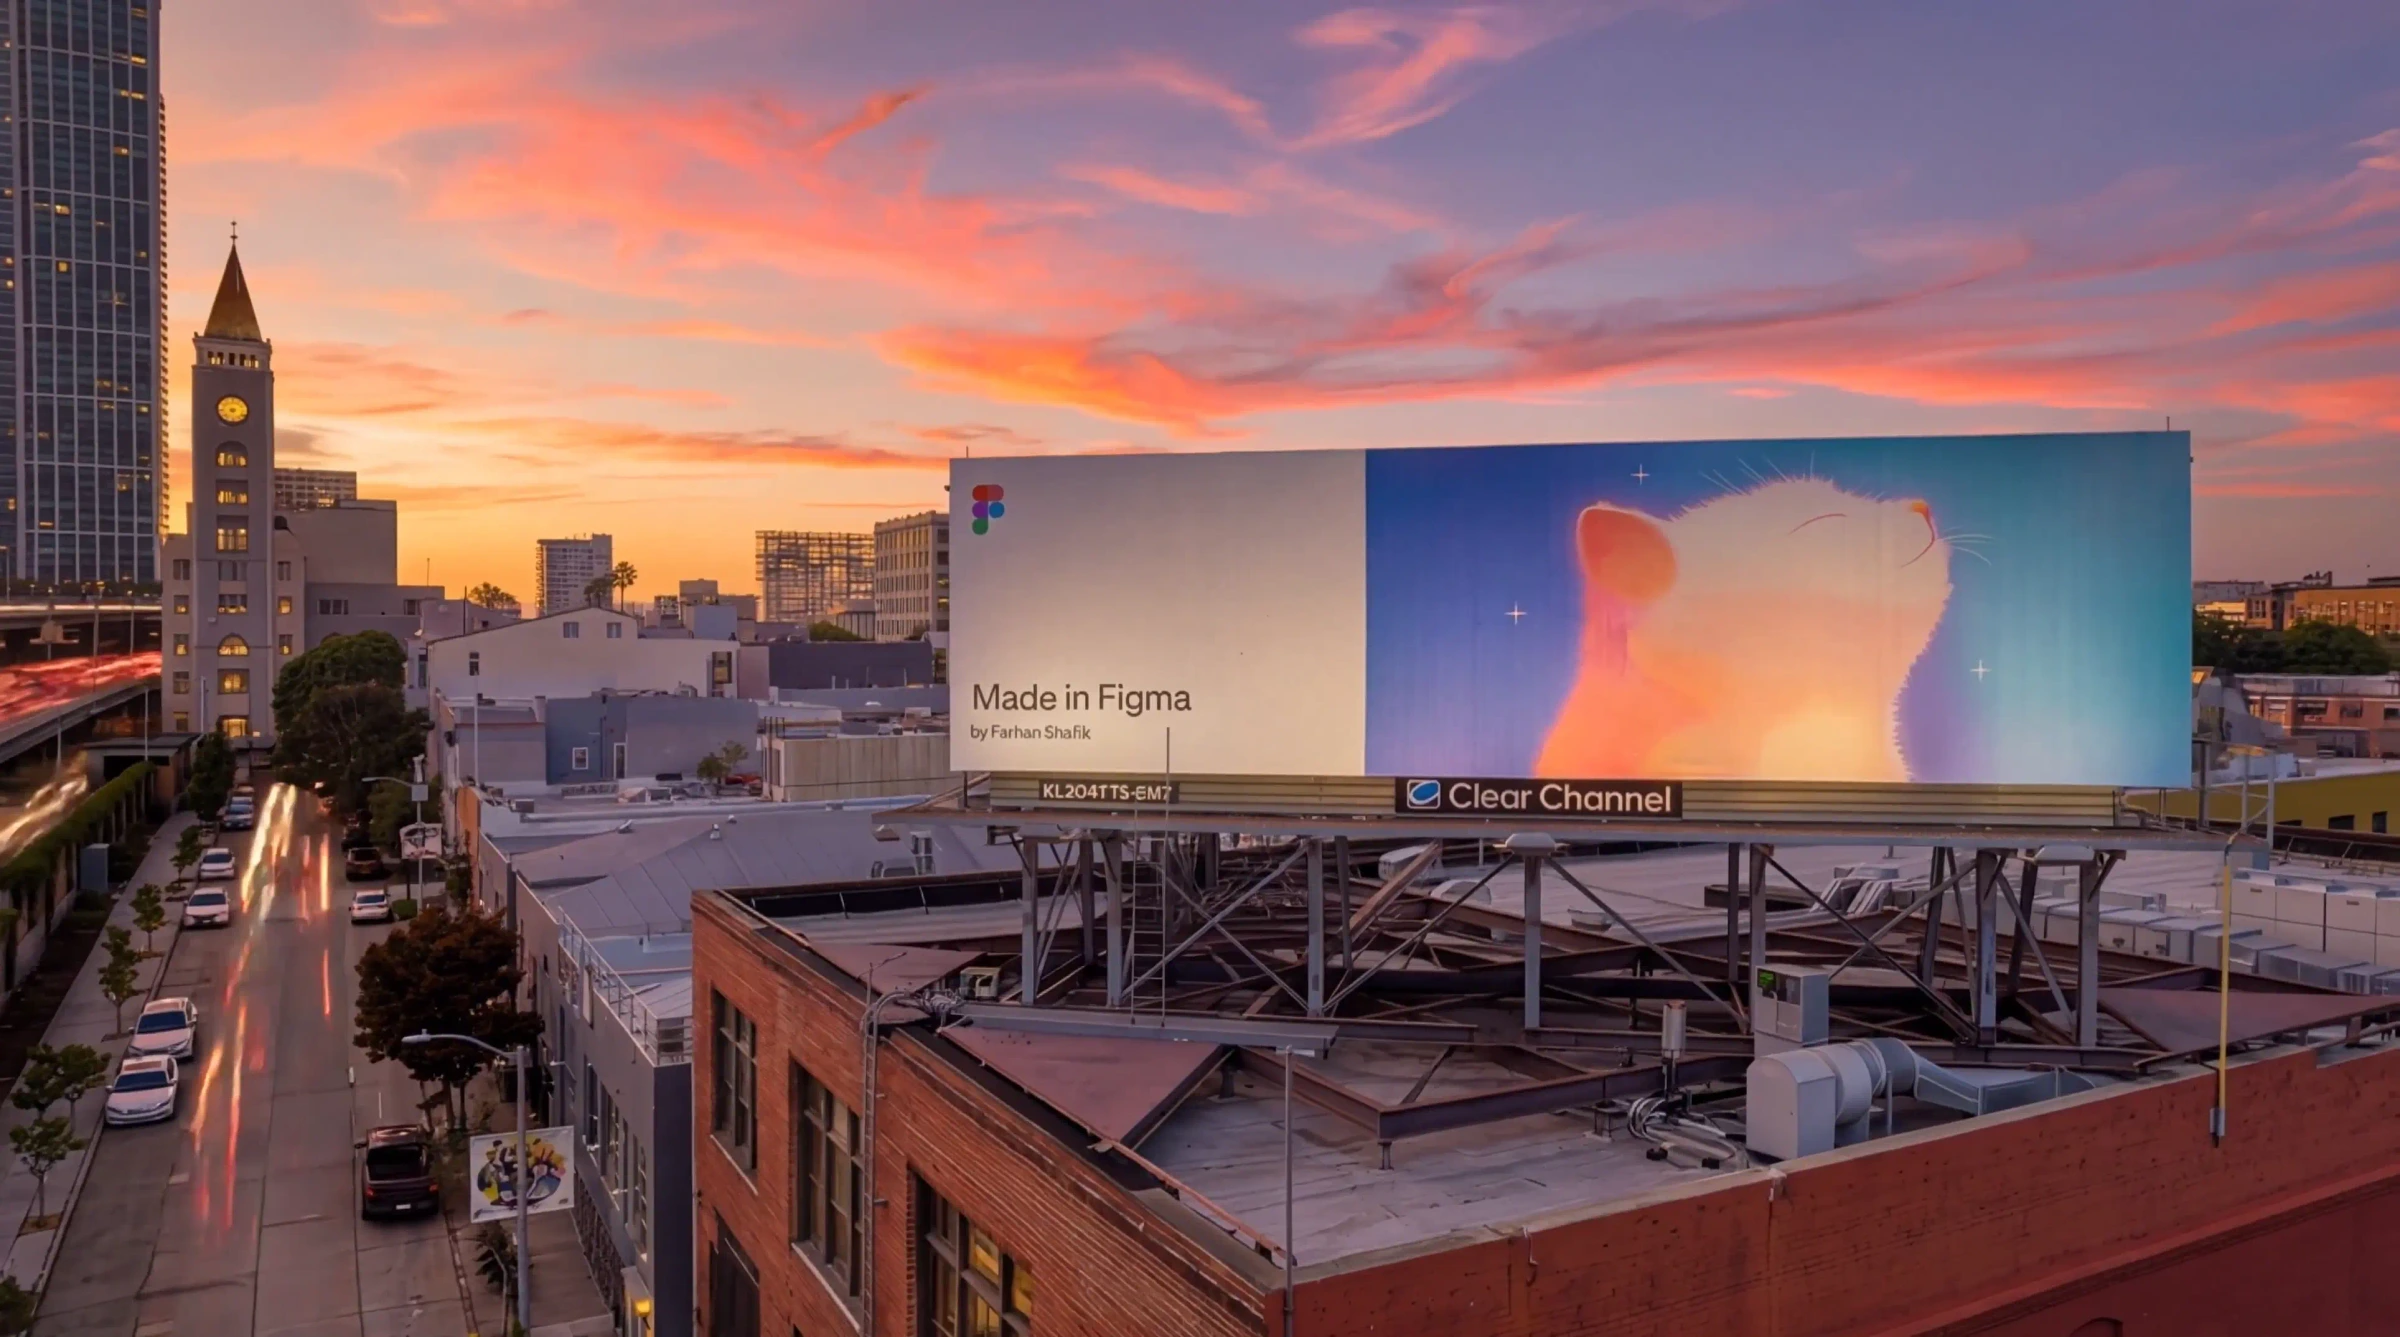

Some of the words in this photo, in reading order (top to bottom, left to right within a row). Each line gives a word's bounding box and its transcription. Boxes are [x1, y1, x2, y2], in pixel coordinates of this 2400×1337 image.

[972, 683, 1056, 711] Made
[1065, 683, 1089, 711] in
[1099, 683, 1192, 718] Figma
[970, 724, 988, 742] by
[991, 725, 1041, 739] Farhan
[1044, 725, 1091, 740] Shafik
[1449, 782, 1532, 810] Clear
[1539, 783, 1671, 813] Channel
